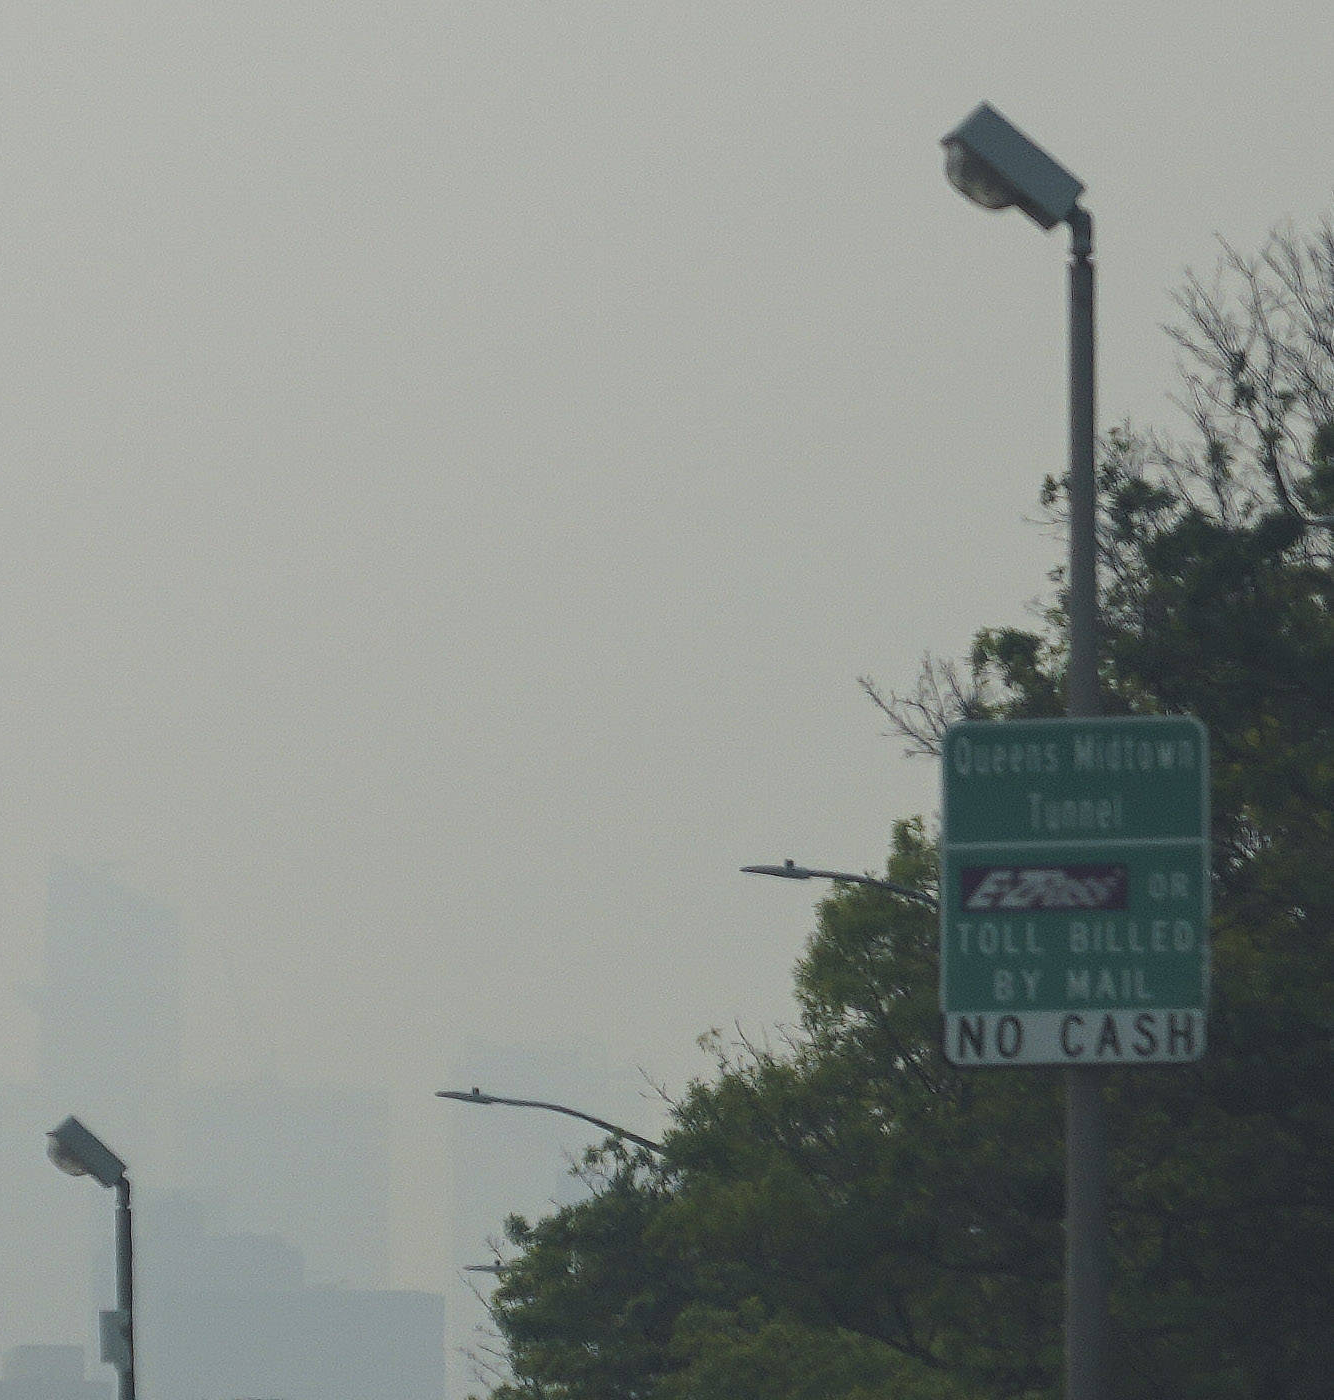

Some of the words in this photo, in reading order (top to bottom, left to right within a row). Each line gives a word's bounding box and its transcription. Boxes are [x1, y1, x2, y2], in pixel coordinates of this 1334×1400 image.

[953, 736, 1059, 777] Queens
[1073, 732, 1195, 772] Midtown
[1027, 791, 1123, 830] Tunnel
[1147, 871, 1189, 898] OR
[956, 922, 1044, 955] TOLL
[1069, 921, 1195, 953] BILLED
[993, 969, 1043, 1001] BY
[1066, 968, 1154, 1000] MAIL
[958, 1014, 1024, 1058] NO
[1061, 1013, 1195, 1057] CASH
